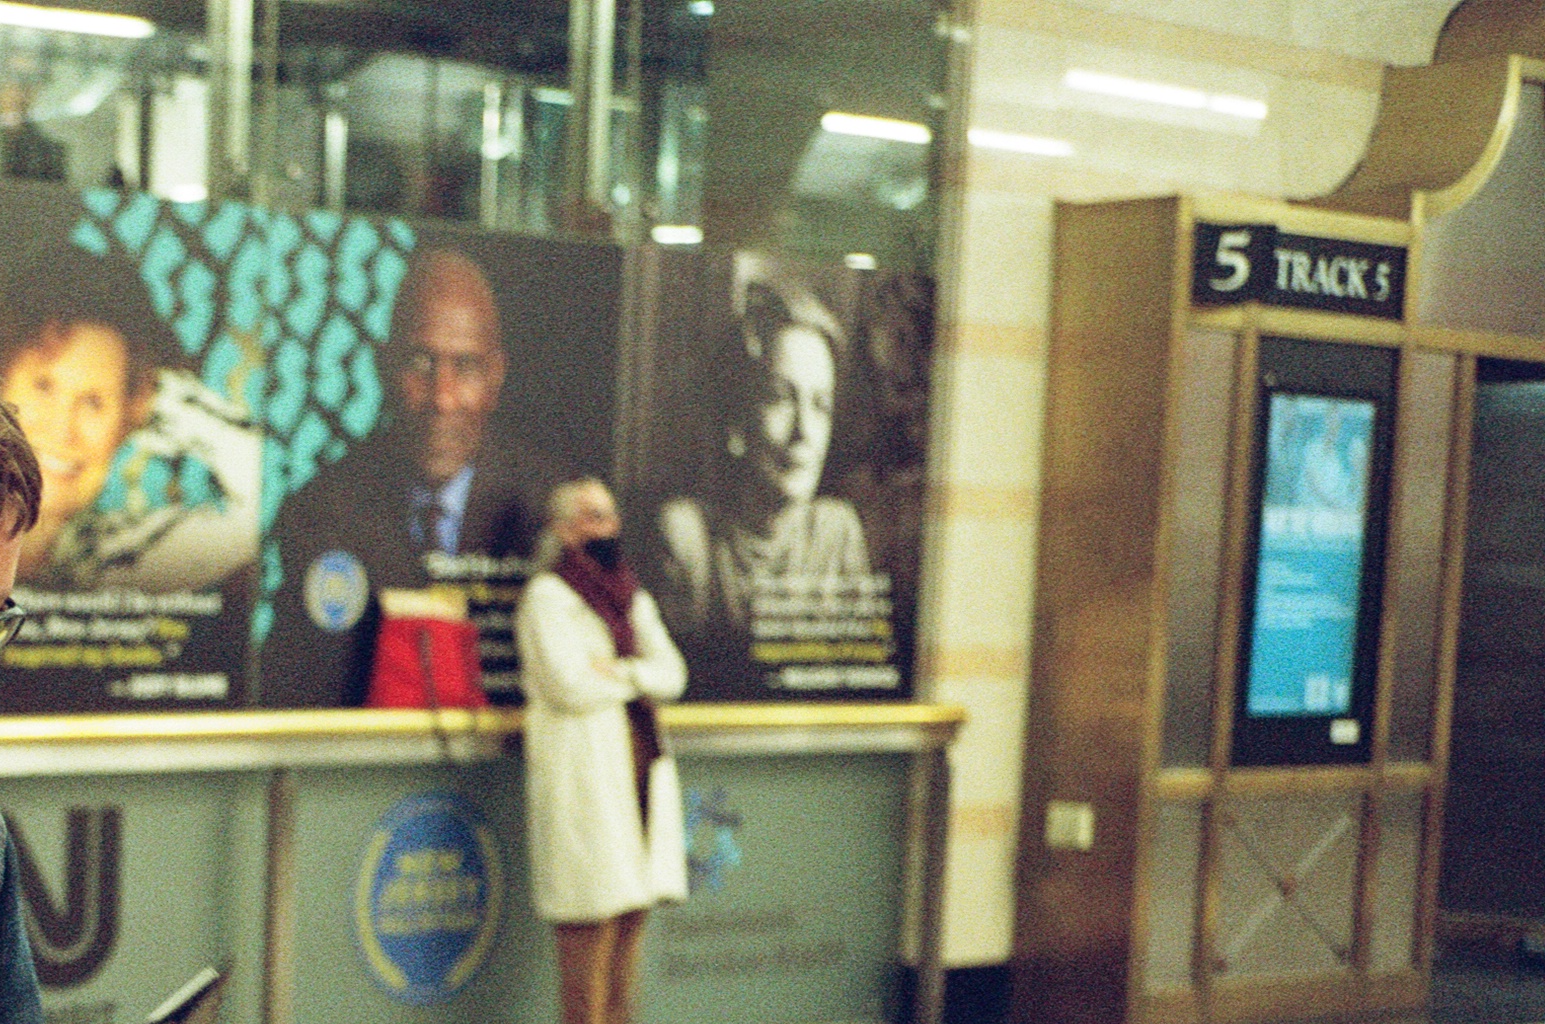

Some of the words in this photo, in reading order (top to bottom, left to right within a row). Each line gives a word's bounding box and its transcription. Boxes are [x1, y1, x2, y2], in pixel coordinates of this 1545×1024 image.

[1209, 231, 1252, 292] 5
[1274, 248, 1369, 300] TRACK
[1373, 262, 1392, 302] 5
